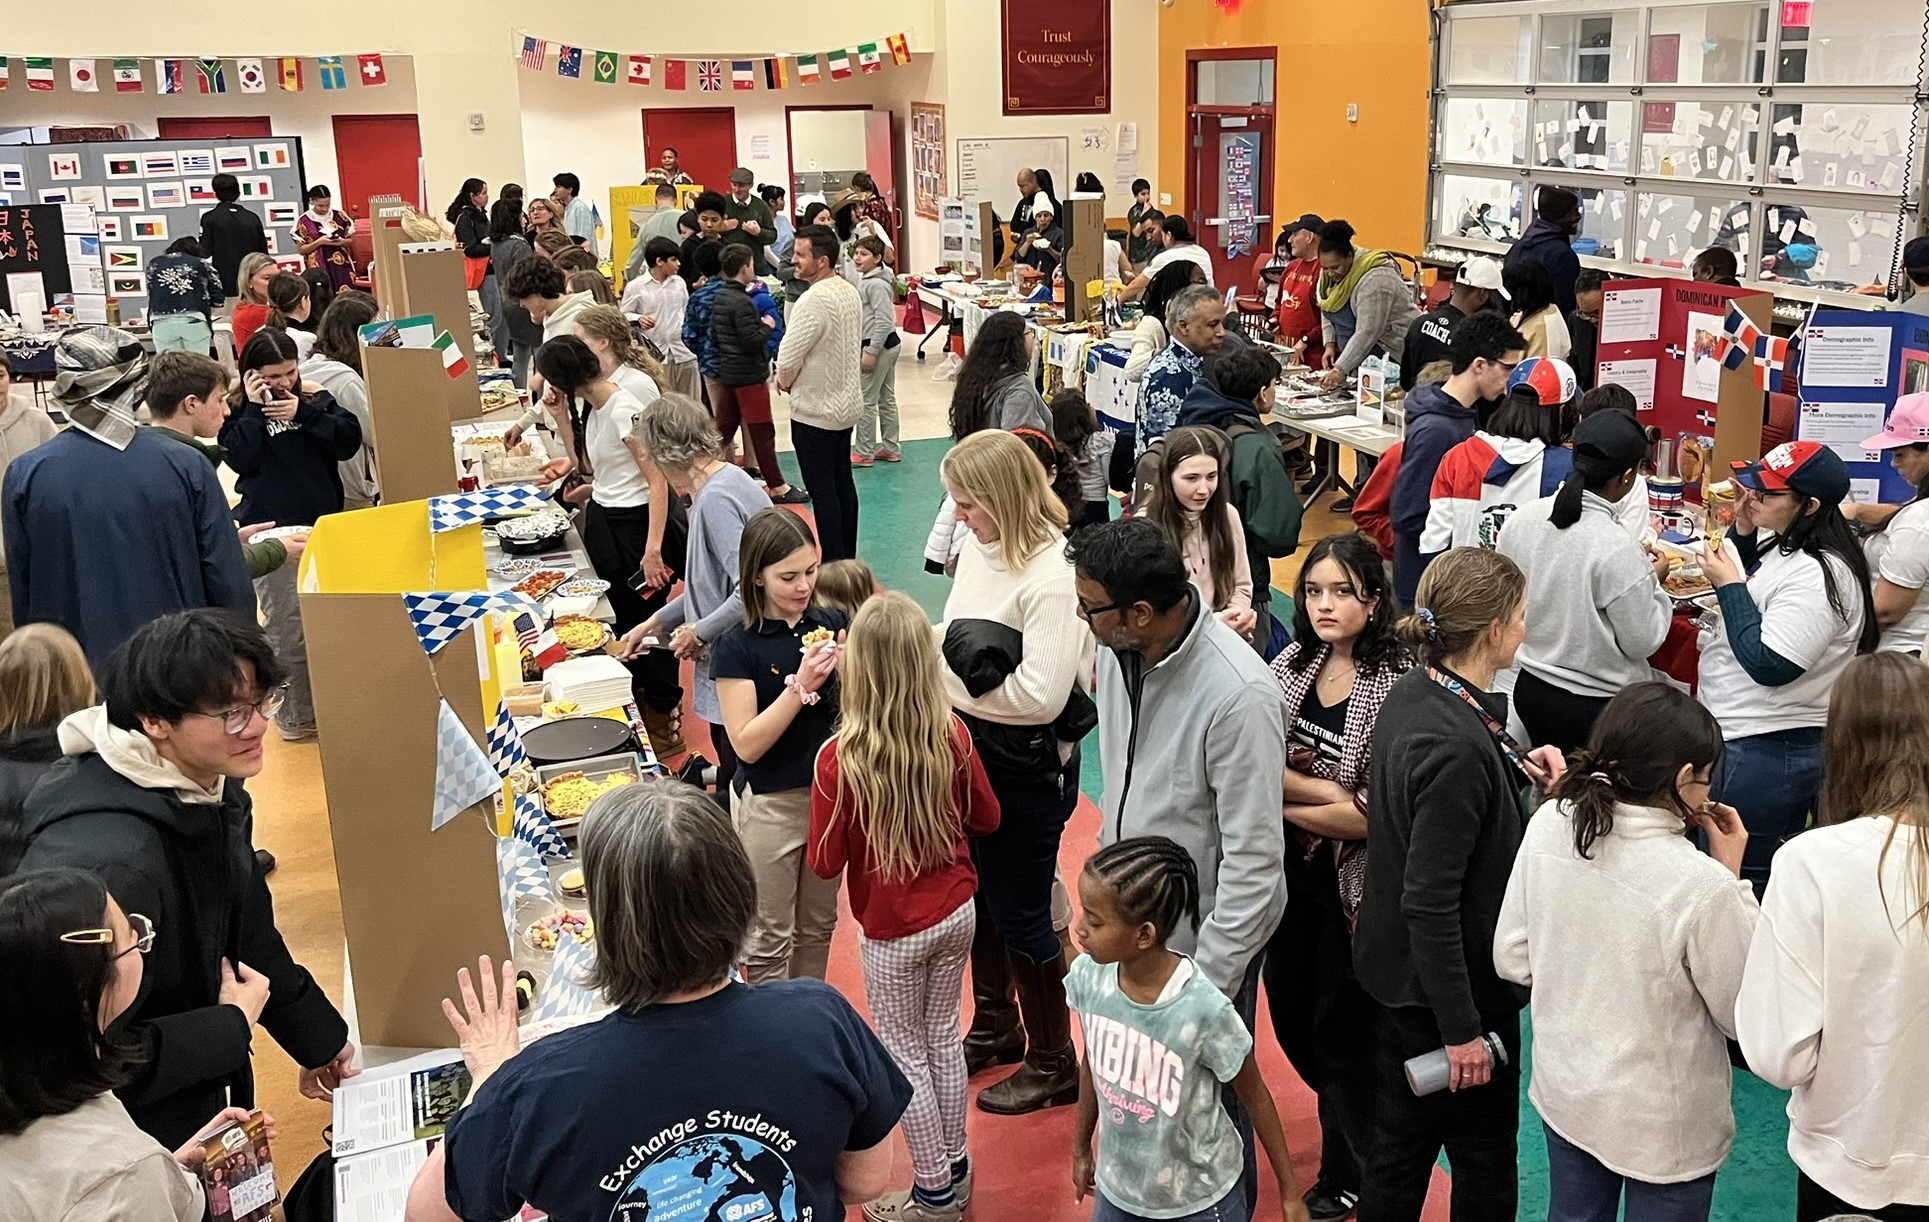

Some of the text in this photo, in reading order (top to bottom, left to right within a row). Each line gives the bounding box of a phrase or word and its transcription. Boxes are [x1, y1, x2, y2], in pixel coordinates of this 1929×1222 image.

[1041, 29, 1072, 43] Trust
[1017, 49, 1096, 67] Courageously
[20, 208, 39, 262] JAPAN
[1675, 288, 1720, 308] DOMINICAN
[1420, 320, 1451, 344] COACH
[1296, 717, 1344, 747] PALESTINIAN
[599, 1109, 798, 1192] Exchange Students
[669, 1186, 703, 1204] changing
[617, 1201, 647, 1212] journey
[653, 1199, 702, 1222] adventure
[743, 1198, 765, 1216] AFS
